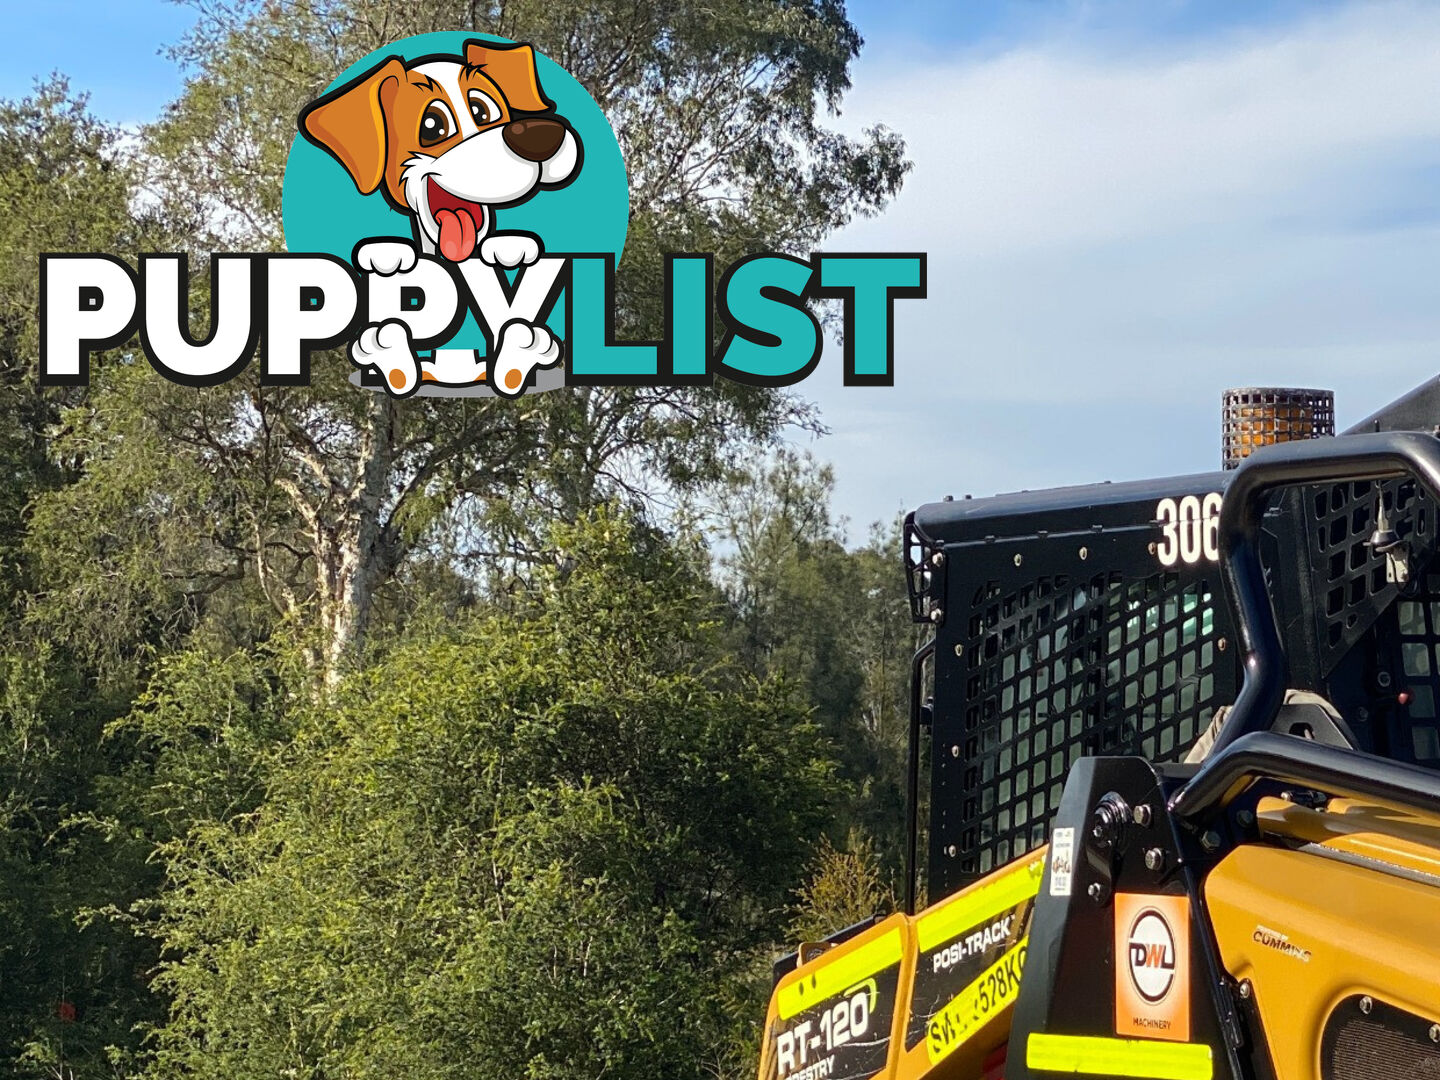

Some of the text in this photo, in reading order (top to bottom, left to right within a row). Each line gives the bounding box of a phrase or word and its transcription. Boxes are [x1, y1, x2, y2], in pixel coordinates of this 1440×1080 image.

[1157, 492, 1222, 566] 306
[933, 916, 1011, 973] POSI-TRACK
[1129, 942, 1175, 970] DWL
[777, 992, 869, 1075] RT-120
[1133, 1017, 1172, 1030] MACHINERY
